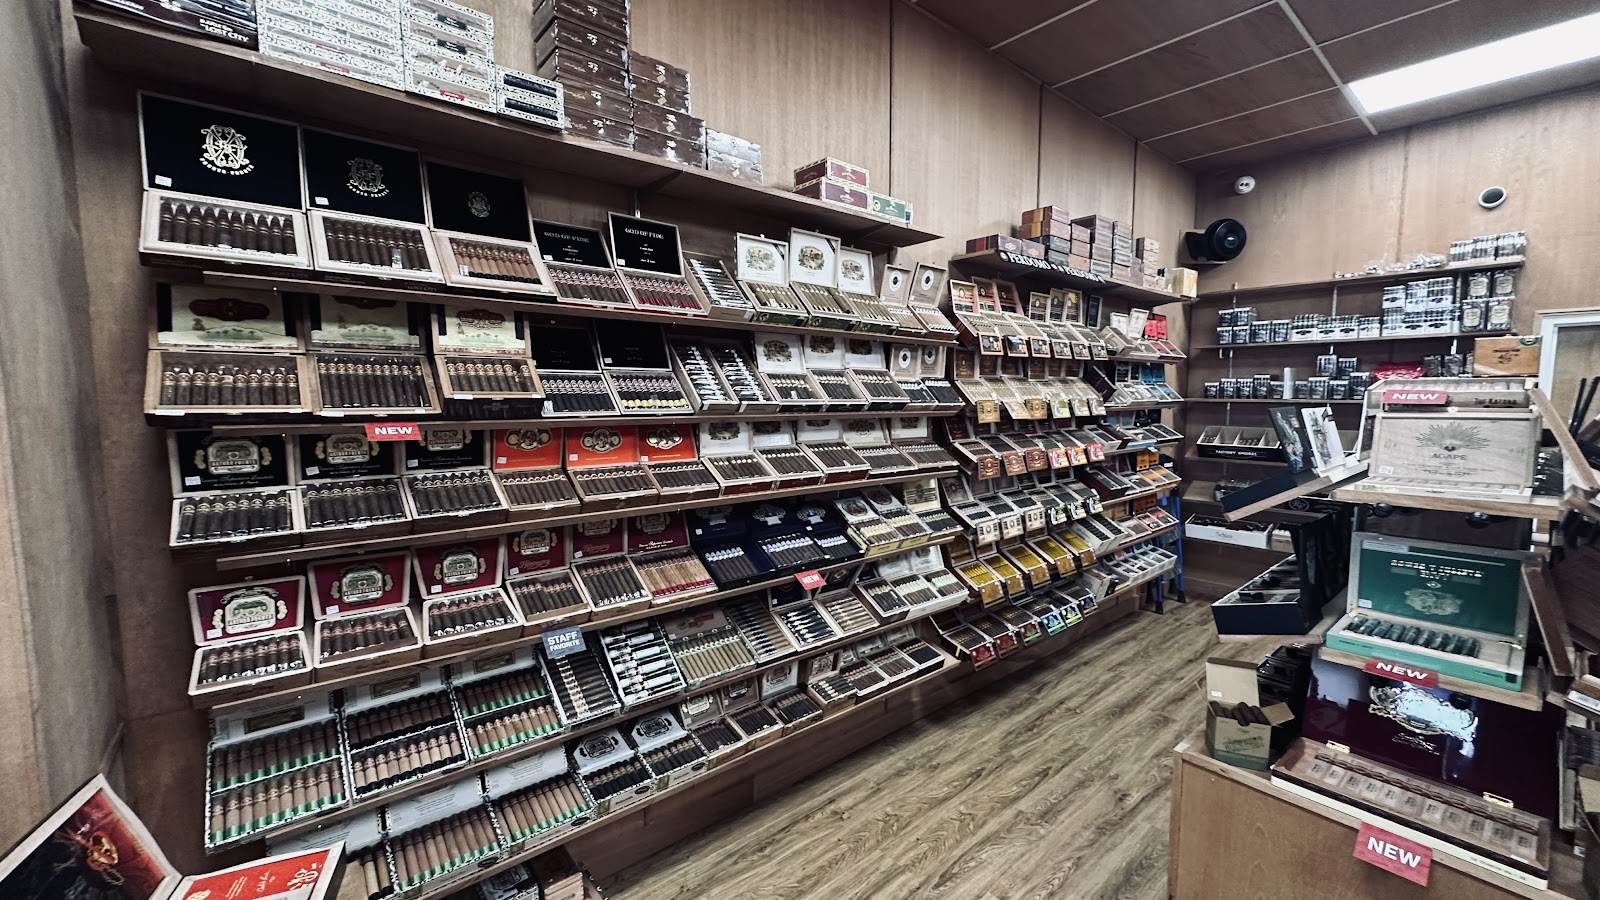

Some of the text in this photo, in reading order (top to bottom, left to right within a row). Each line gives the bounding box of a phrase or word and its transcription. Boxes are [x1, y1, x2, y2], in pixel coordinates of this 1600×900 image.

[205, 26, 250, 43] LOST CITY
[1007, 252, 1052, 270] PERDOMO
[374, 426, 413, 435] NEW
[1431, 453, 1468, 461] AGAPE
[801, 573, 820, 585] NEW
[547, 631, 578, 646] STAFF
[549, 638, 581, 652] FAVORITE
[1375, 661, 1429, 680] NEW
[1367, 836, 1422, 868] NEW
